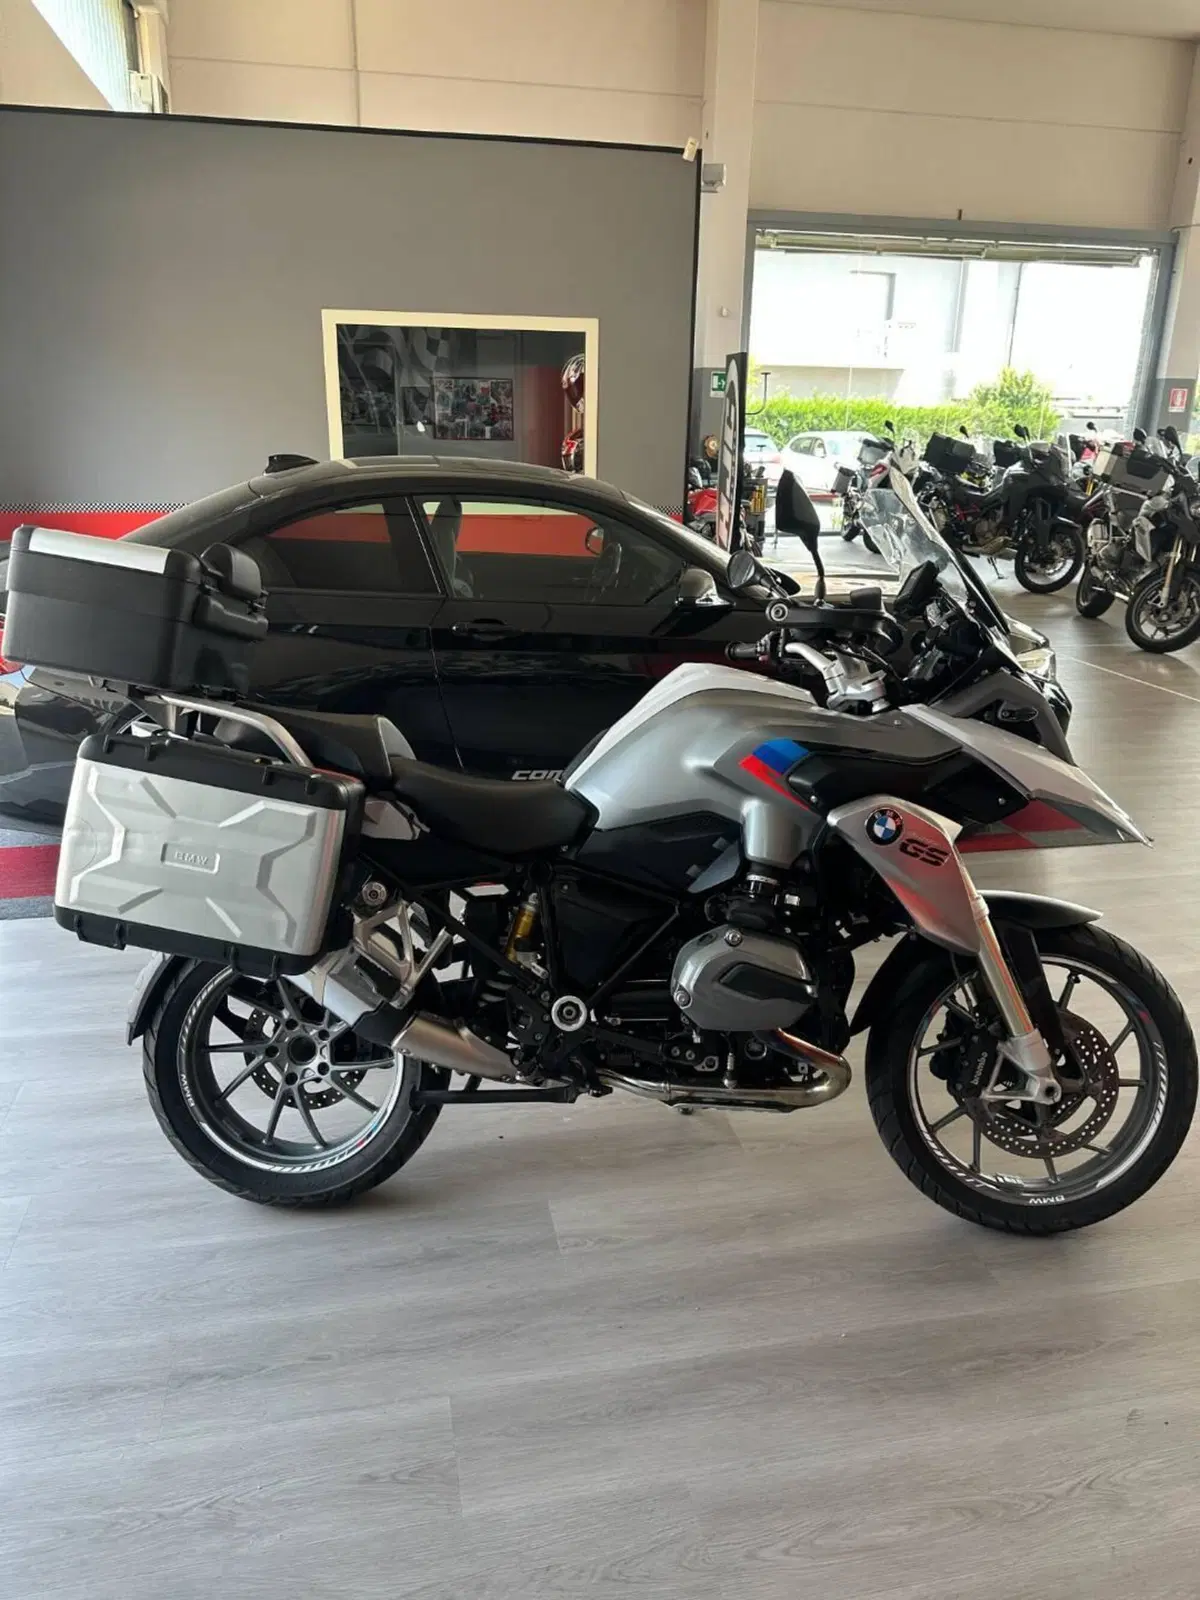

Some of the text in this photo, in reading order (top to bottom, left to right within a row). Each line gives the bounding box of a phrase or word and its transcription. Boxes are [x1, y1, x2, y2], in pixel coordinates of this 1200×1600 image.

[174, 850, 209, 866] BMW
[899, 838, 948, 866] GS
[971, 1051, 988, 1085] brembo
[180, 1073, 195, 1107] BMW
[1029, 1195, 1066, 1204] BMW
